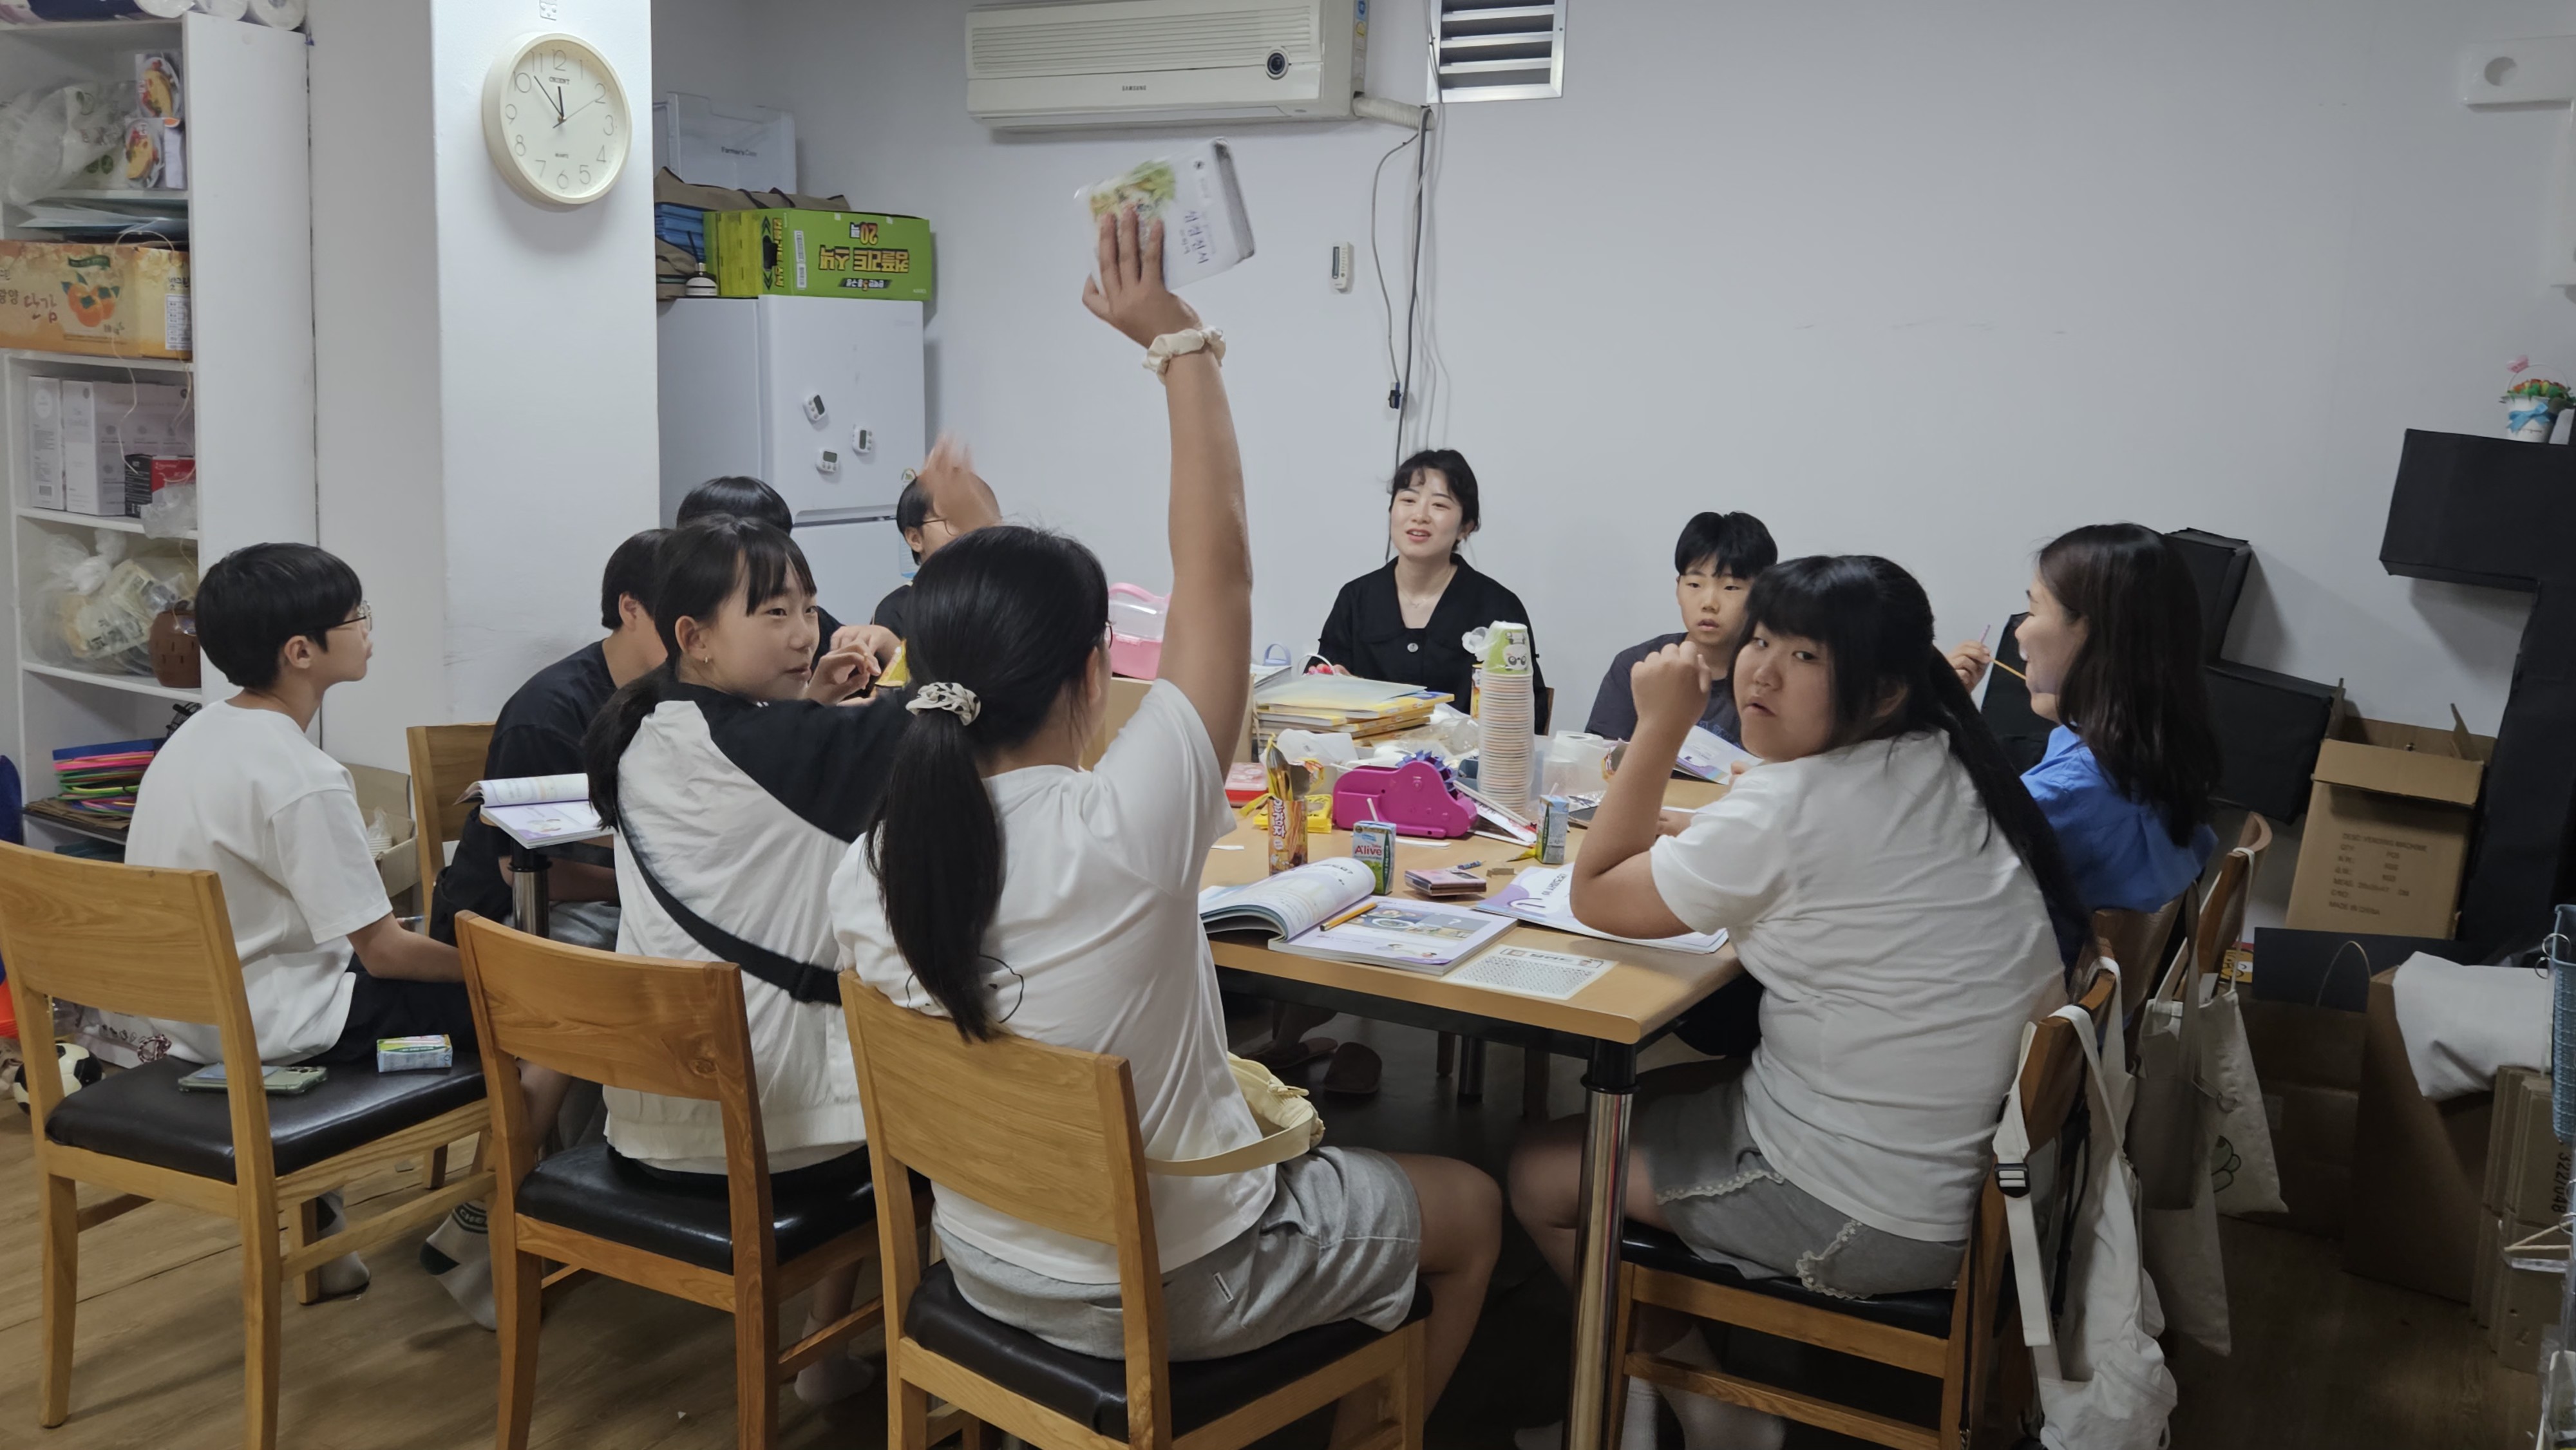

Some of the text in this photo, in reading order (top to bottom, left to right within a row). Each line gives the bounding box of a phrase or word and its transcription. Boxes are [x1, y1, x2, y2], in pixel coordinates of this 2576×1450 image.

[529, 50, 543, 73] 11
[552, 49, 567, 71] 12
[513, 70, 532, 93] 10
[594, 82, 607, 104] 2
[505, 104, 517, 124] 9
[603, 115, 614, 136] 3
[515, 134, 526, 156] 8
[596, 144, 607, 162] 4
[535, 159, 546, 178] 7
[556, 169, 569, 189] 6
[580, 164, 591, 185] 5
[818, 245, 909, 273] 컴플리트 스낵
[24, 292, 58, 324] 단감
[2329, 901, 2348, 910] MADE
[2359, 906, 2380, 915] CHINA
